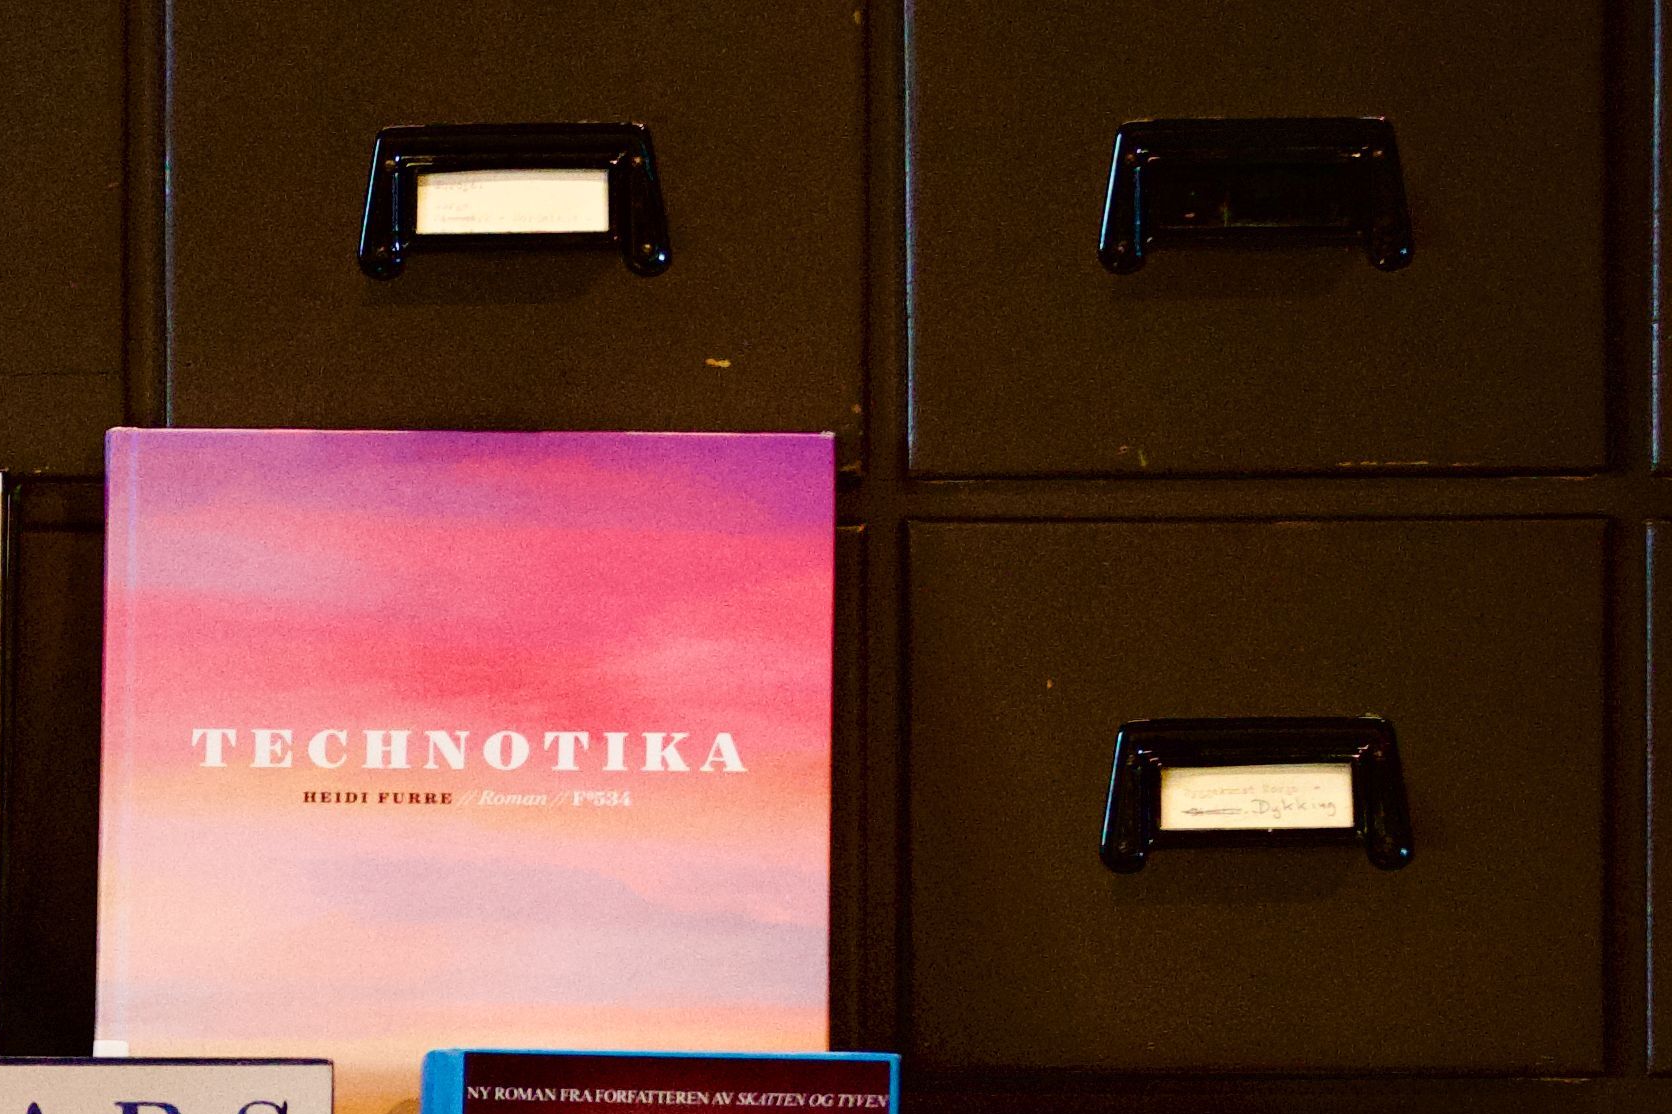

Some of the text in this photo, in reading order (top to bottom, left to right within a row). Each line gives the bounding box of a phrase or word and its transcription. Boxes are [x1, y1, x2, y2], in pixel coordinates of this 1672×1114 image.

[190, 728, 748, 773] TECHNOTIKA
[302, 791, 368, 804] HEIDI
[378, 791, 453, 805] FURRE
[478, 790, 548, 807] Roman
[467, 1086, 891, 1108] NY ROMAN FRA FORFATTEREN AV SKATTEN OG TYVEN
